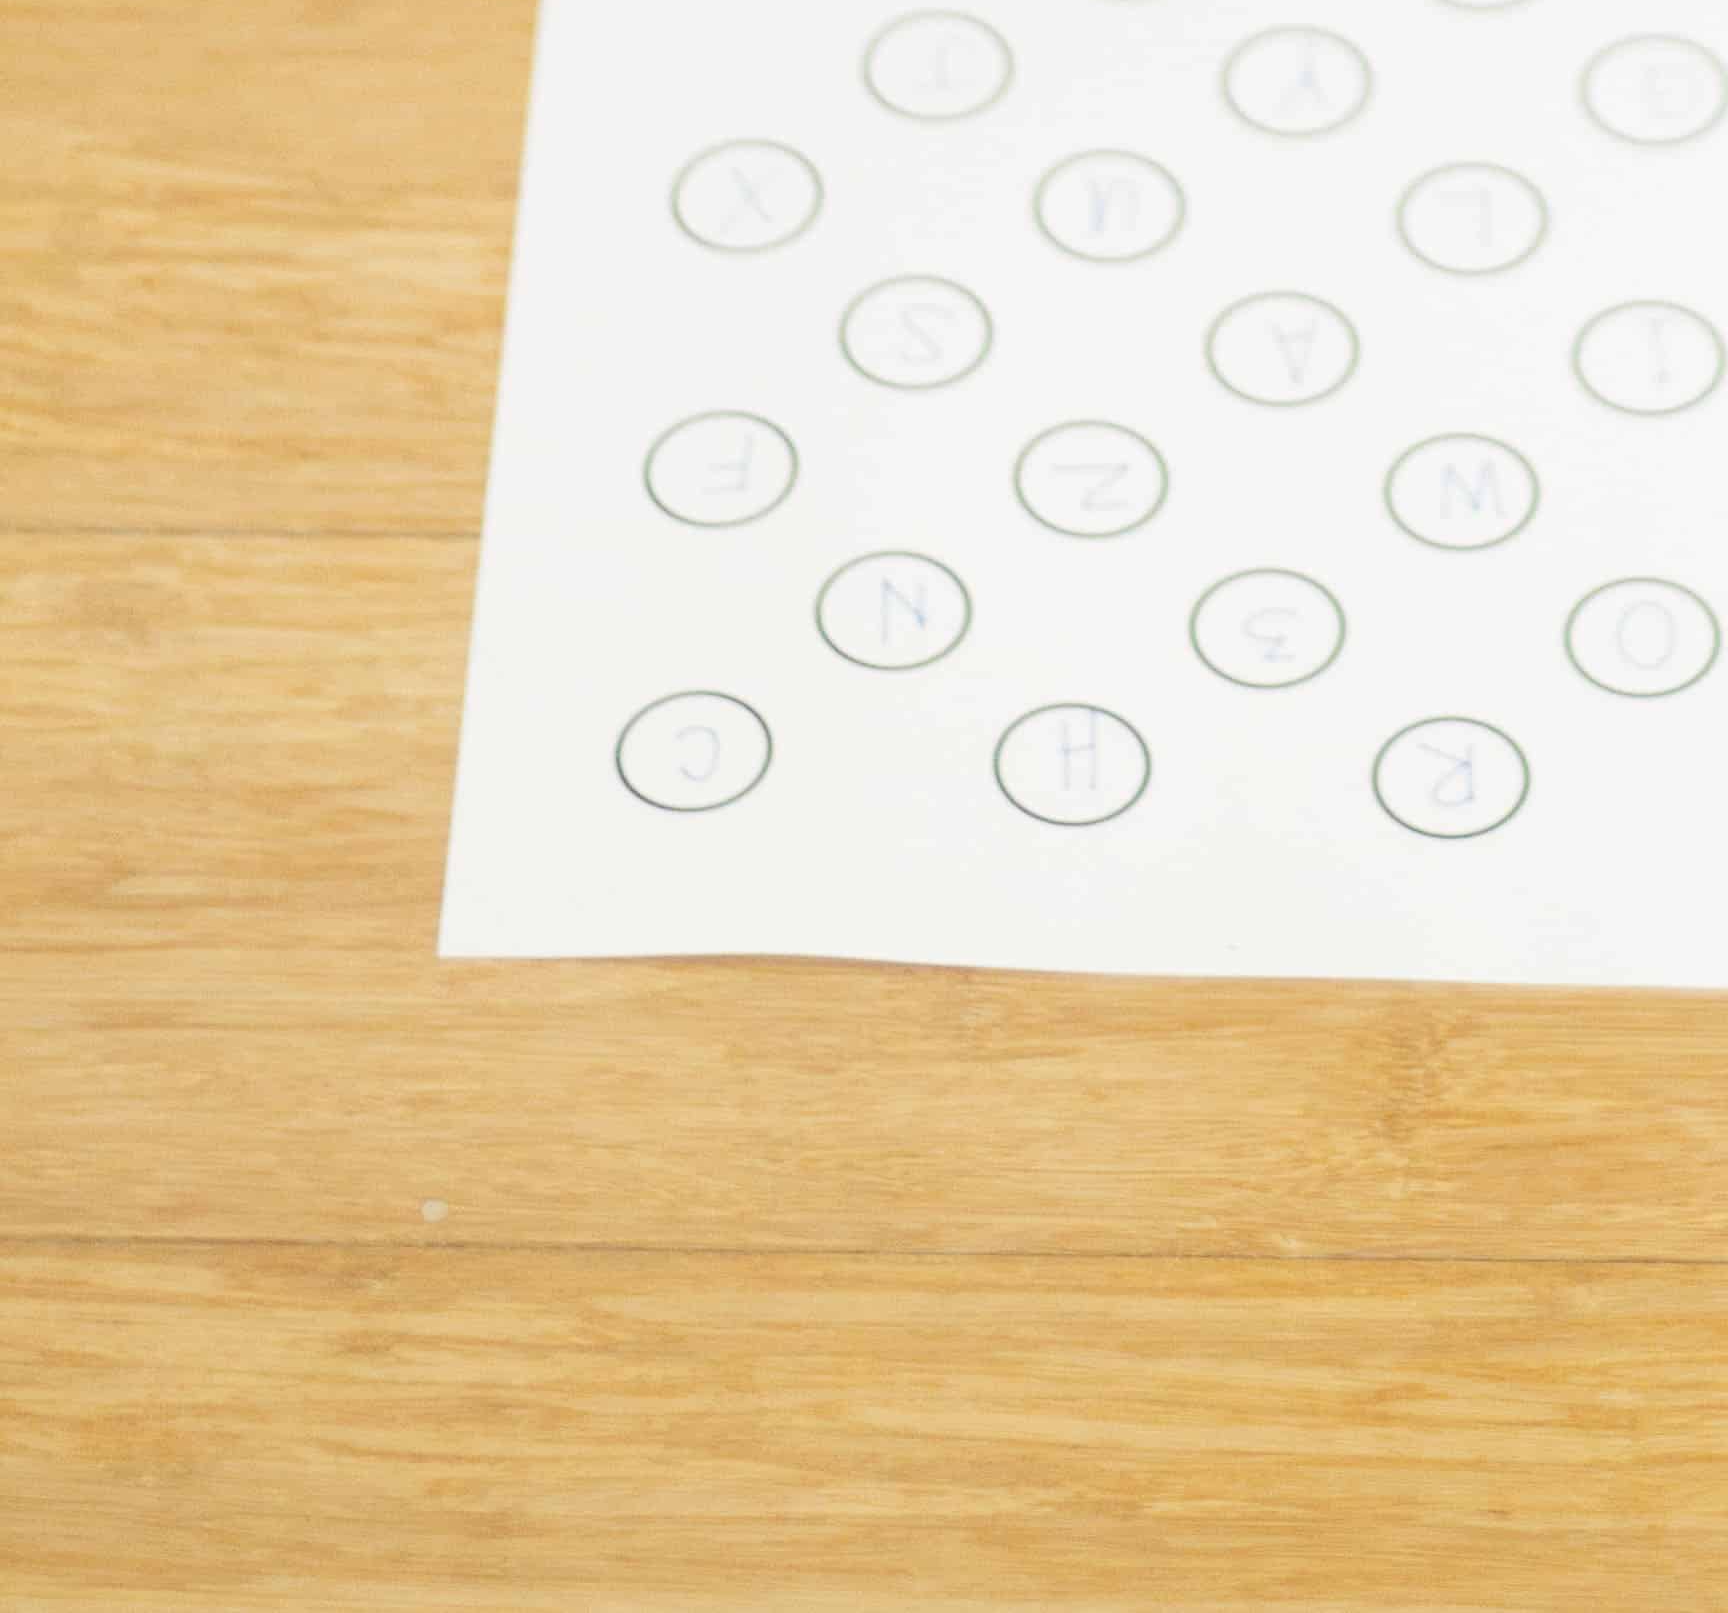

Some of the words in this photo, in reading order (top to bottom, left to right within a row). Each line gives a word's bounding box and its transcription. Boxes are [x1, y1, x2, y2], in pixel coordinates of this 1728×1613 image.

[715, 166, 784, 236] X
[1433, 186, 1495, 250] L
[898, 302, 956, 366] S
[1266, 317, 1319, 386] A
[699, 433, 755, 496] F
[1050, 461, 1130, 512] Z
[1438, 457, 1507, 521] W
[880, 578, 930, 646] N
[1240, 605, 1299, 664] 3
[1614, 599, 1679, 672] O
[674, 724, 722, 784] C
[1058, 711, 1098, 793] H
[1416, 743, 1475, 809] R
